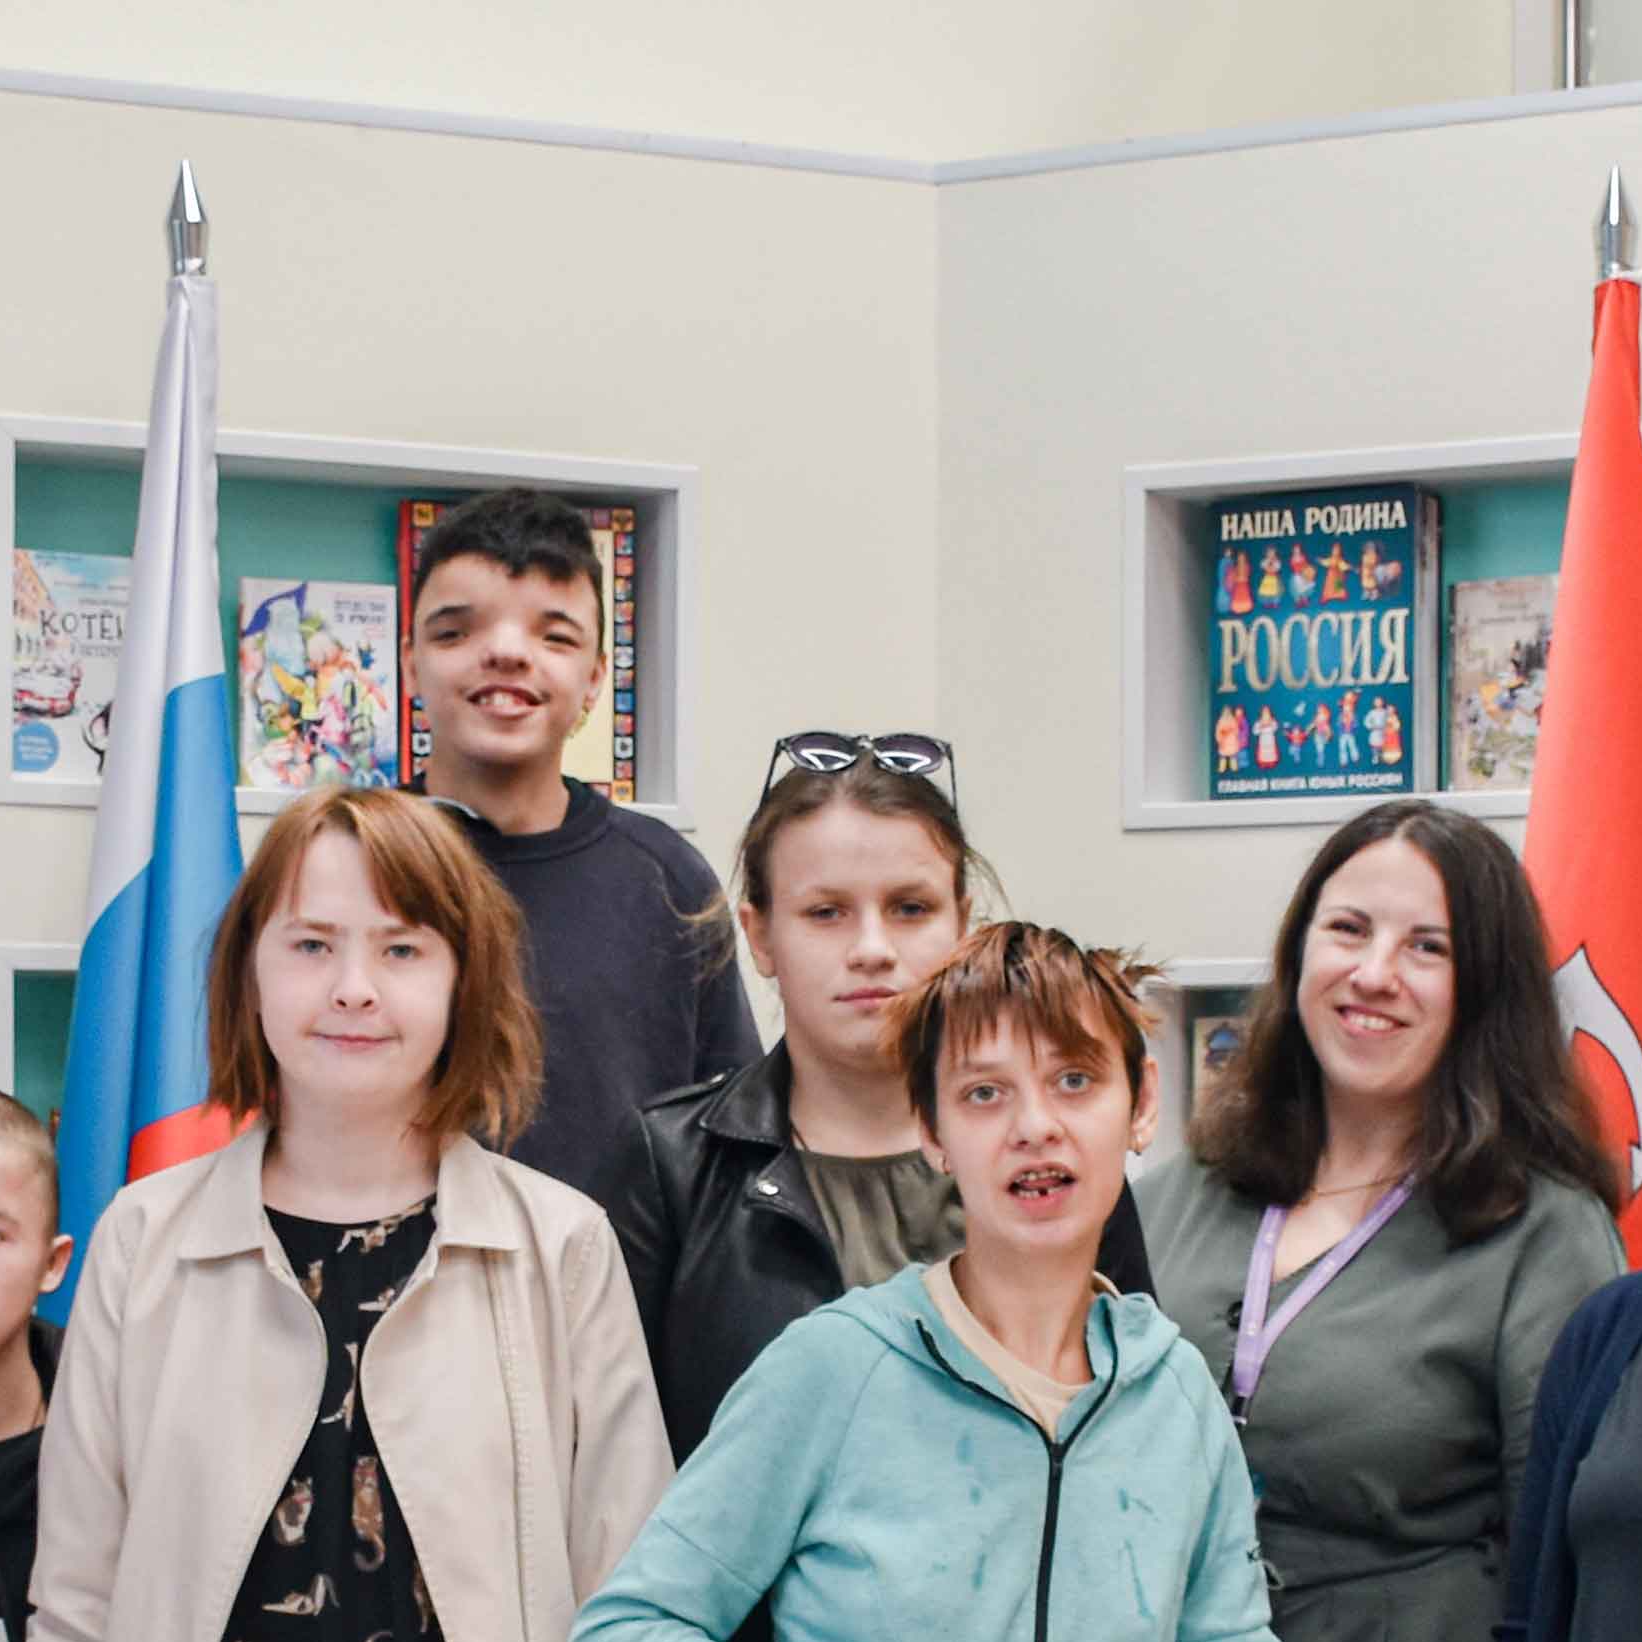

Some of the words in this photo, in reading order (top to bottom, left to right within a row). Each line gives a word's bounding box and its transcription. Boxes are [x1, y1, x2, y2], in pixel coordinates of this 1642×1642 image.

[1221, 508, 1296, 541] НАША
[1304, 500, 1407, 535] РОДИНА
[1216, 607, 1410, 694] РОССИЯ
